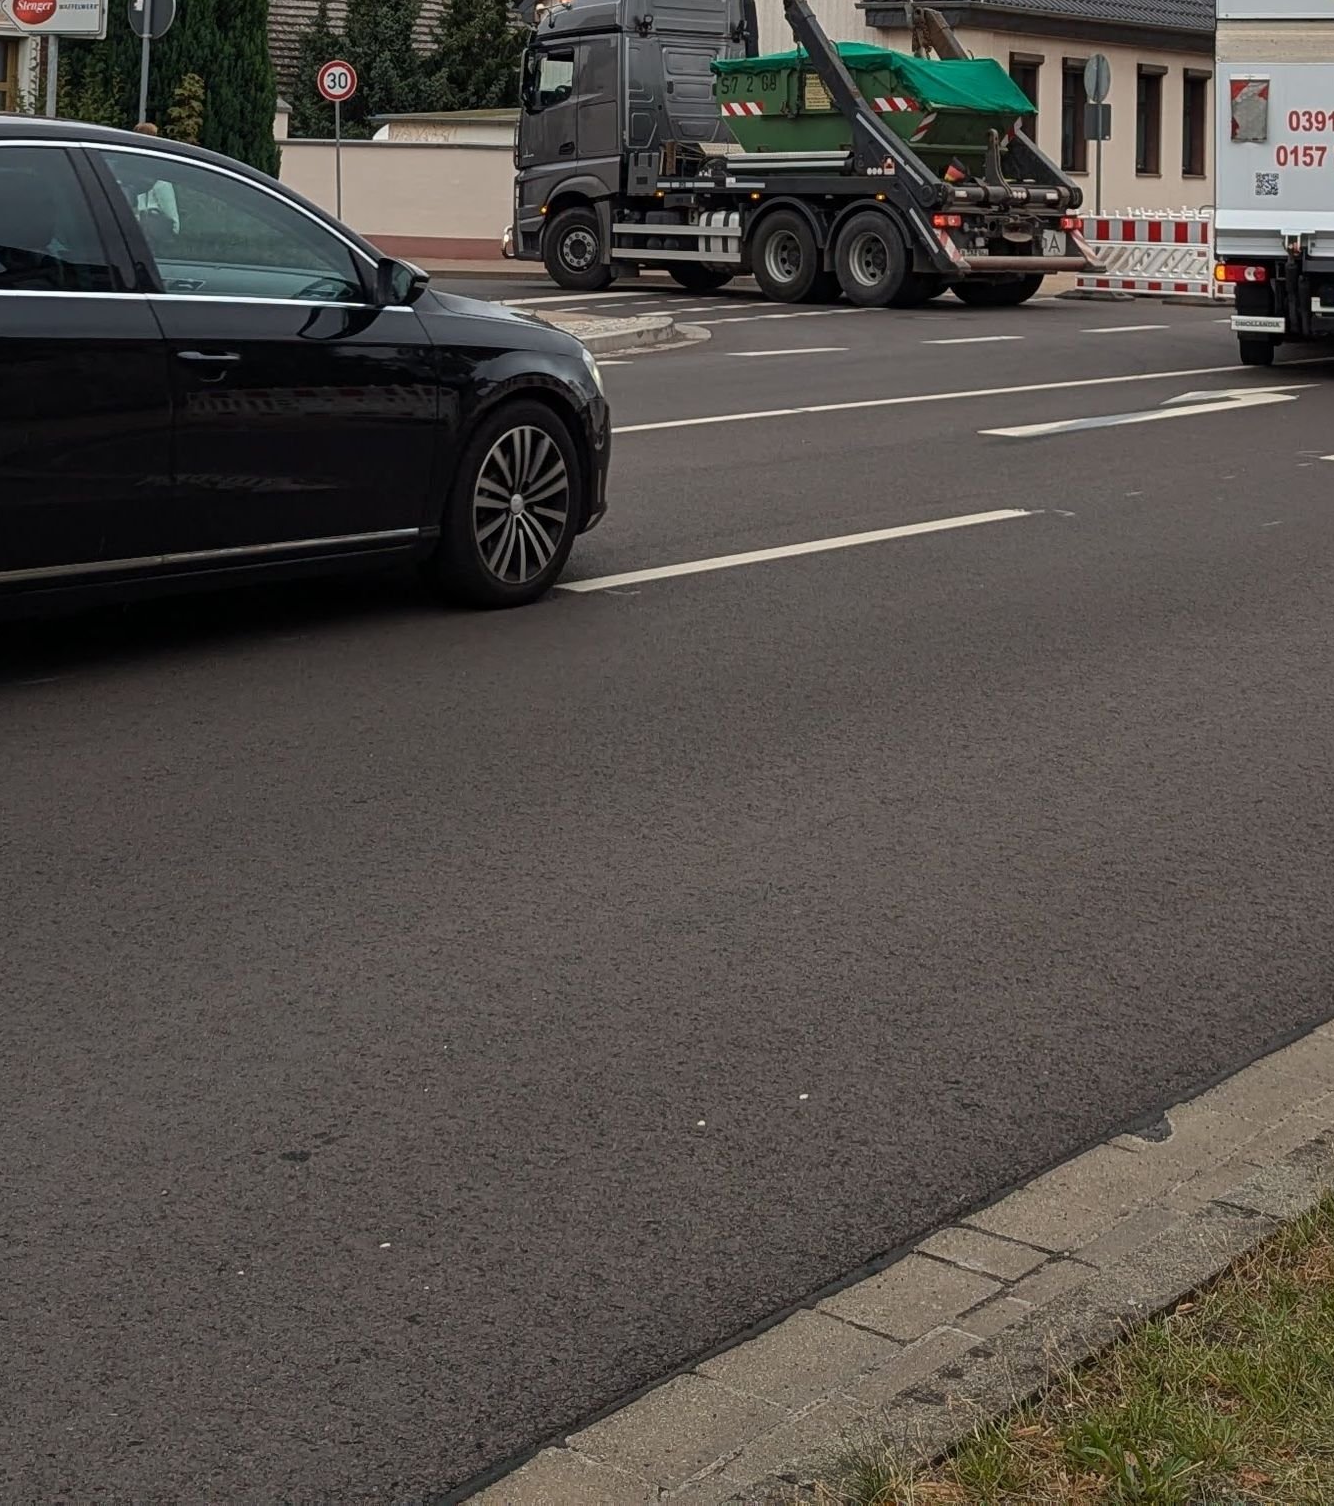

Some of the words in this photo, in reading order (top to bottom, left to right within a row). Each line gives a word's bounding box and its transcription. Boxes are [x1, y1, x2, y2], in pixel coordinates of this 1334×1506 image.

[16, 0, 54, 14] Stenger
[327, 72, 348, 90] 30
[1275, 145, 1327, 167] 0157
